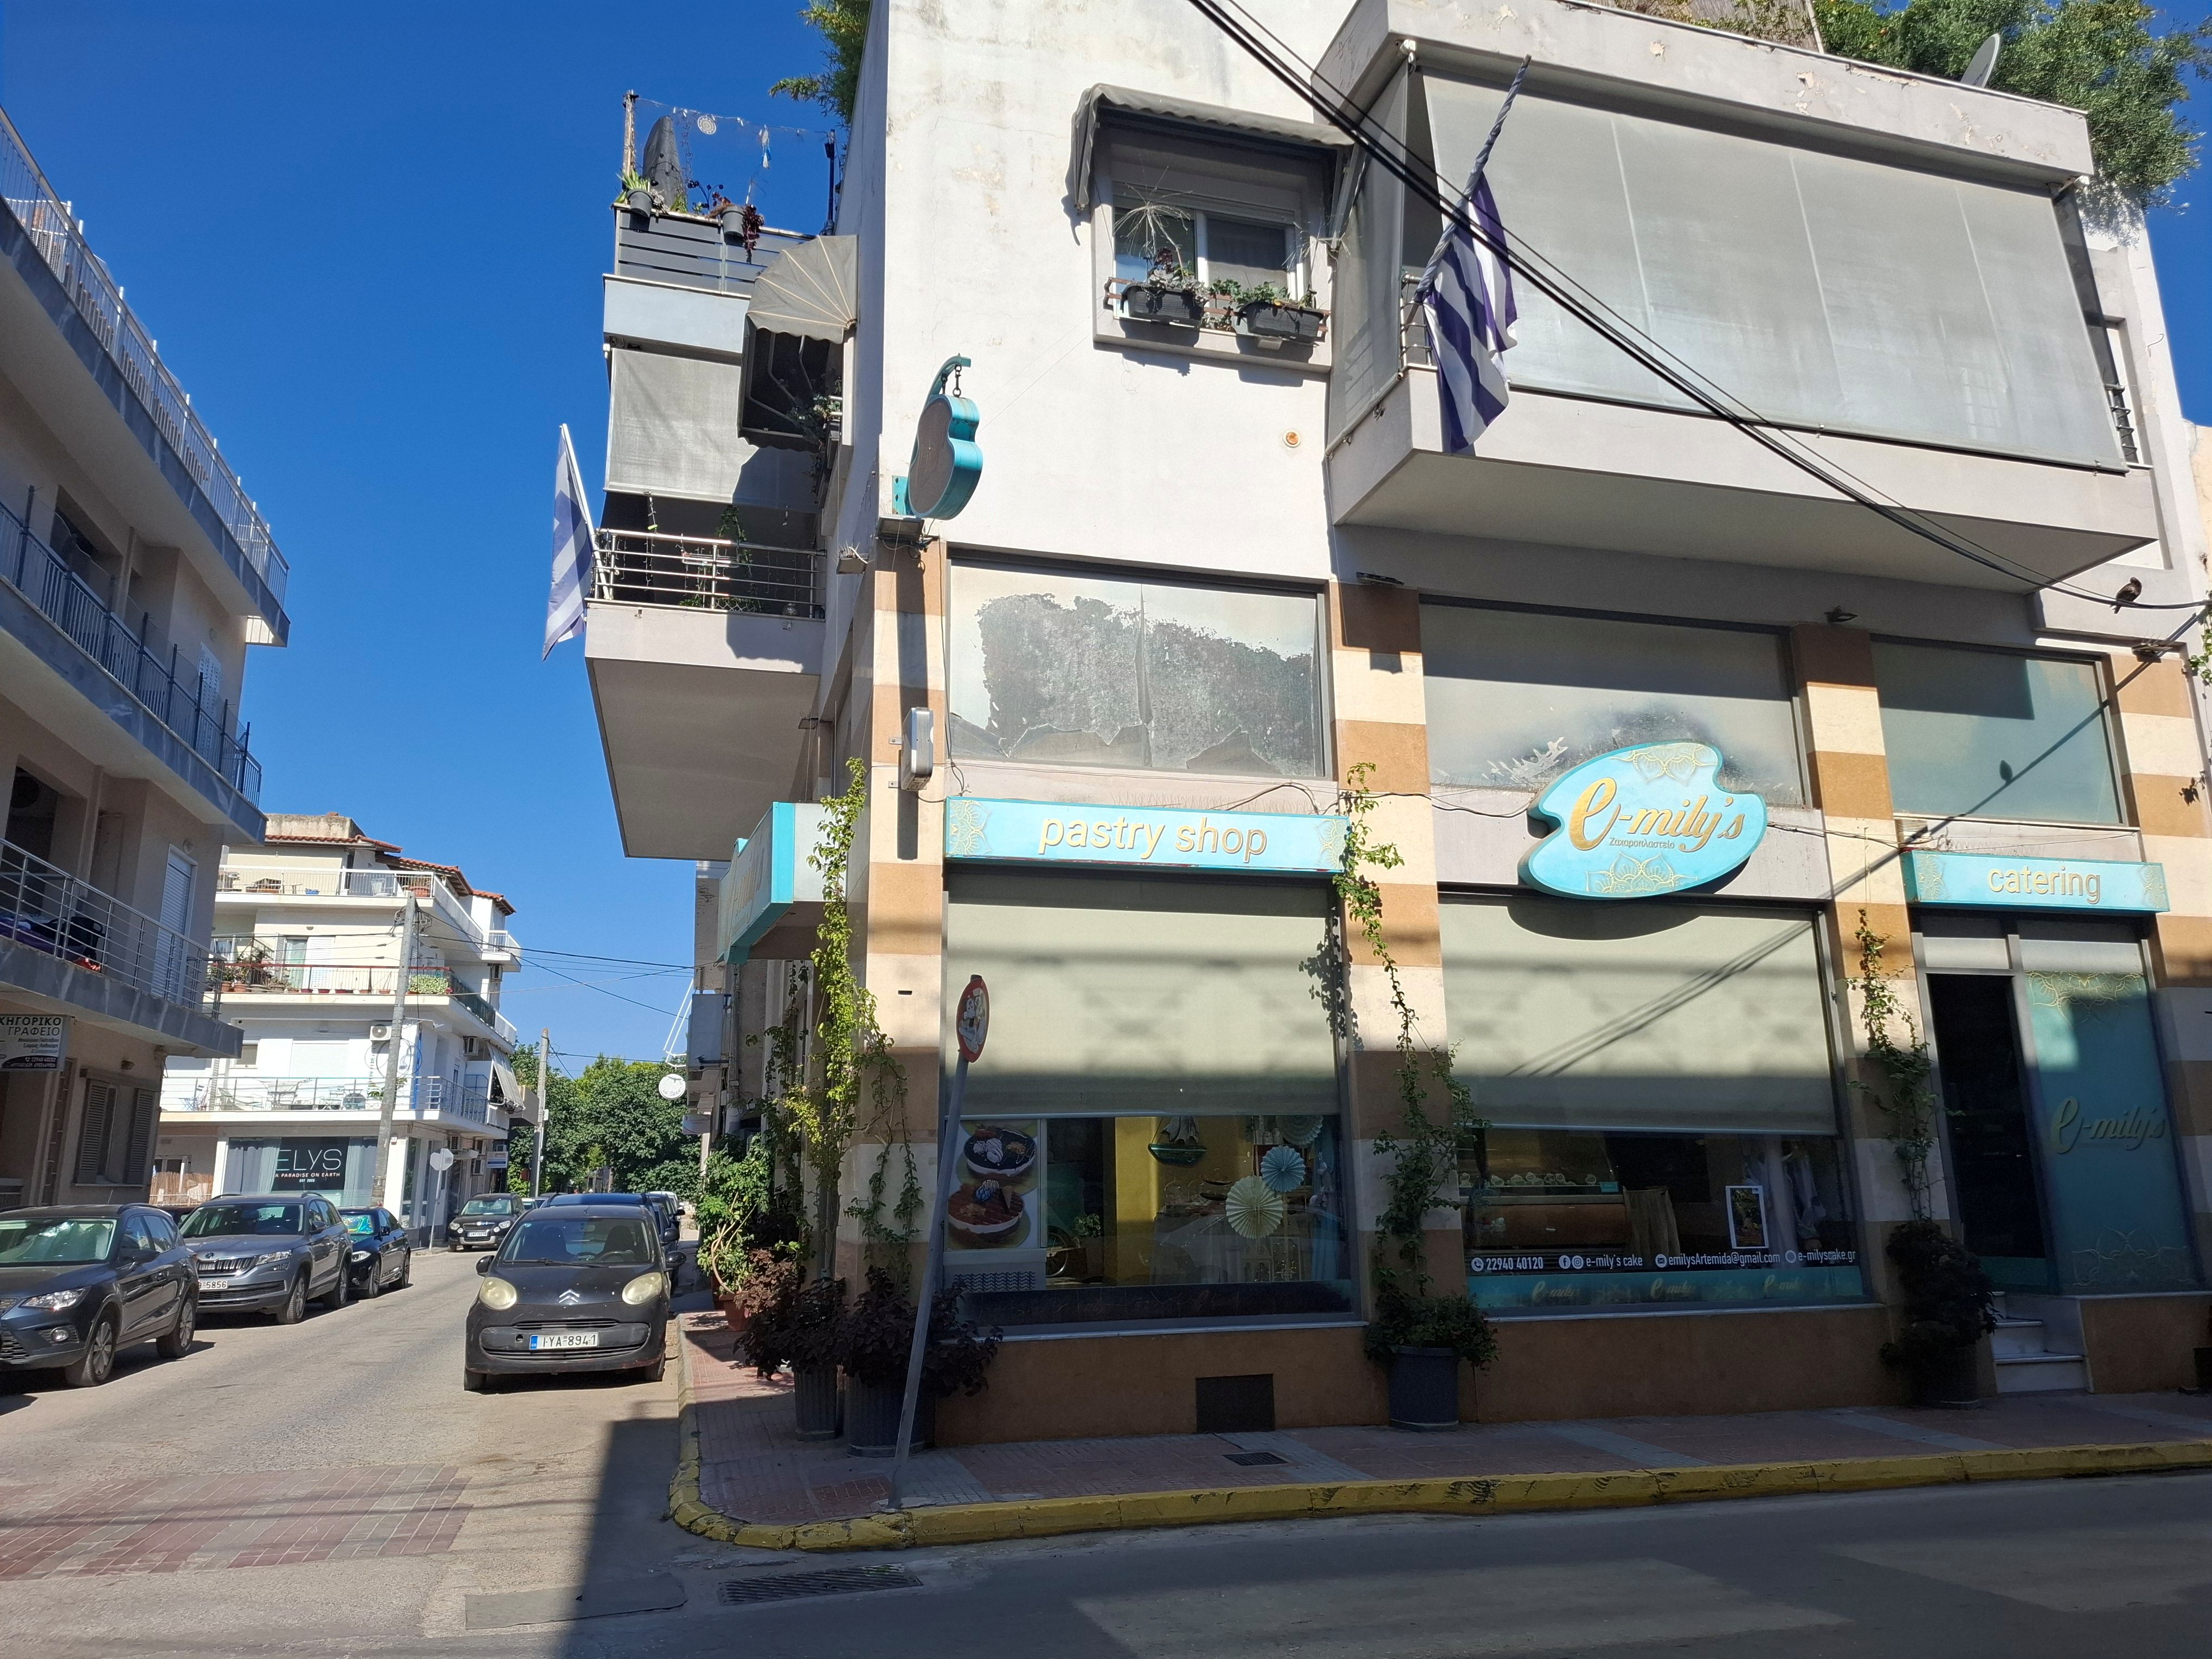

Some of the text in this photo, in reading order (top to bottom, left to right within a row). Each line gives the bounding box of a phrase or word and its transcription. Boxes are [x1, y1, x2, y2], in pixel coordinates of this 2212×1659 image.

[1569, 777, 1745, 852] e-mily's
[1038, 815, 1268, 863] pastry shop
[1988, 866, 2101, 904] catering
[8, 1027, 60, 1036] ΓΡΑΦΕΙΟ
[275, 1149, 342, 1170] ELYS
[1486, 1248, 1856, 1270] 22940 40120 e-mily's cake emilysArtemida@gmail.com e-milyscake.gr
